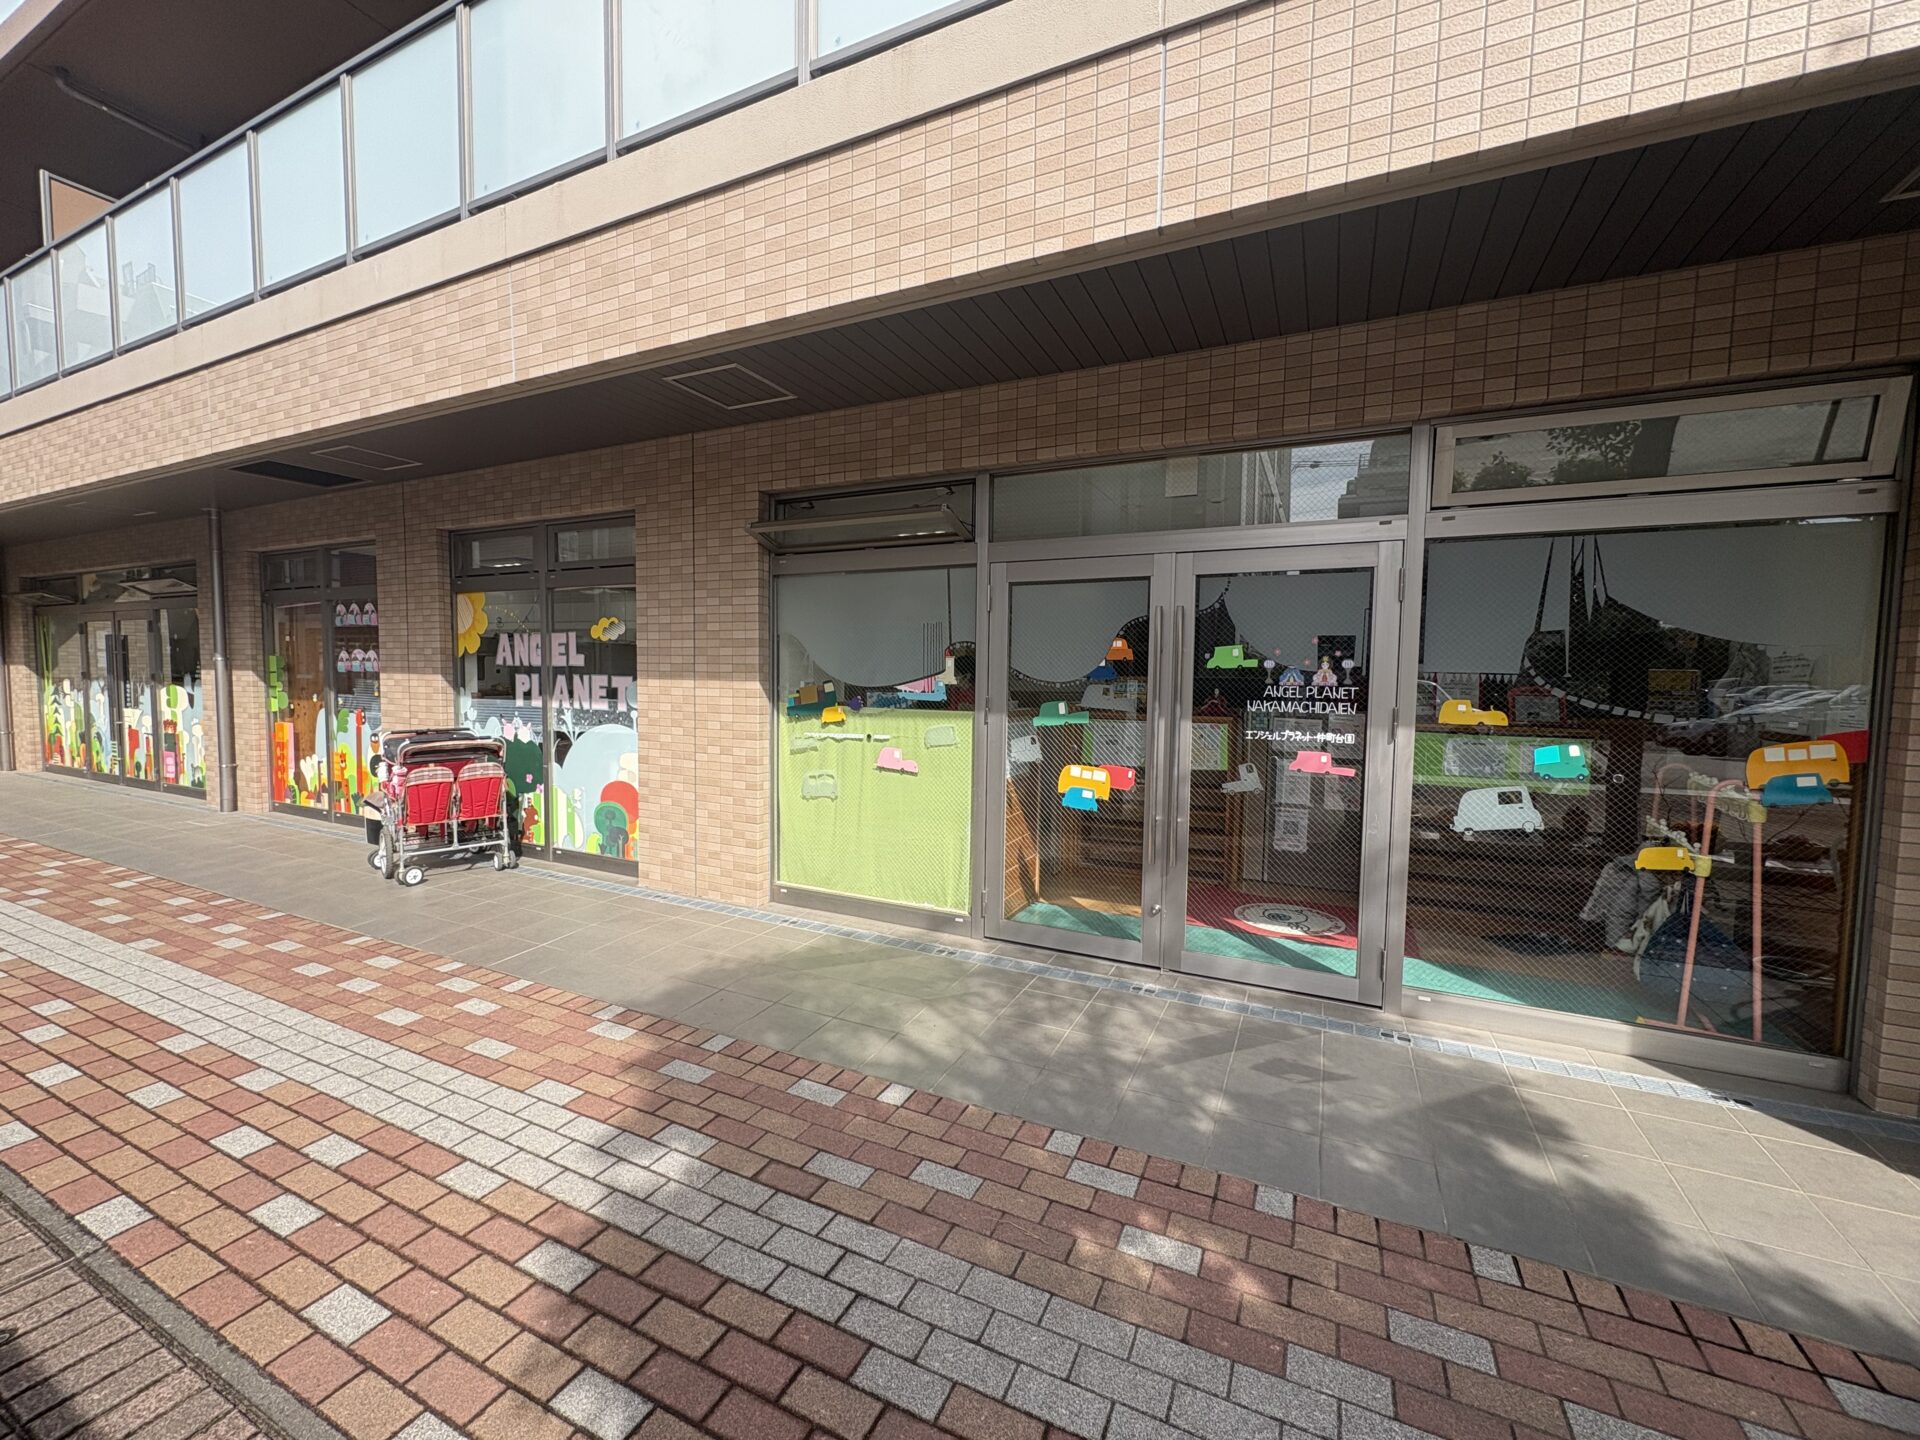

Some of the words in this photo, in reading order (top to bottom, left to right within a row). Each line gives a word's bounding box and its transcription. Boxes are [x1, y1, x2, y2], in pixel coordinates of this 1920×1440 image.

[496, 632, 584, 667] ANGEL
[515, 674, 632, 712] PLANET
[1263, 686, 1303, 699] ANGEL
[1306, 686, 1359, 700] PLANET
[1247, 700, 1357, 715] NAKAMACHIDAIEN
